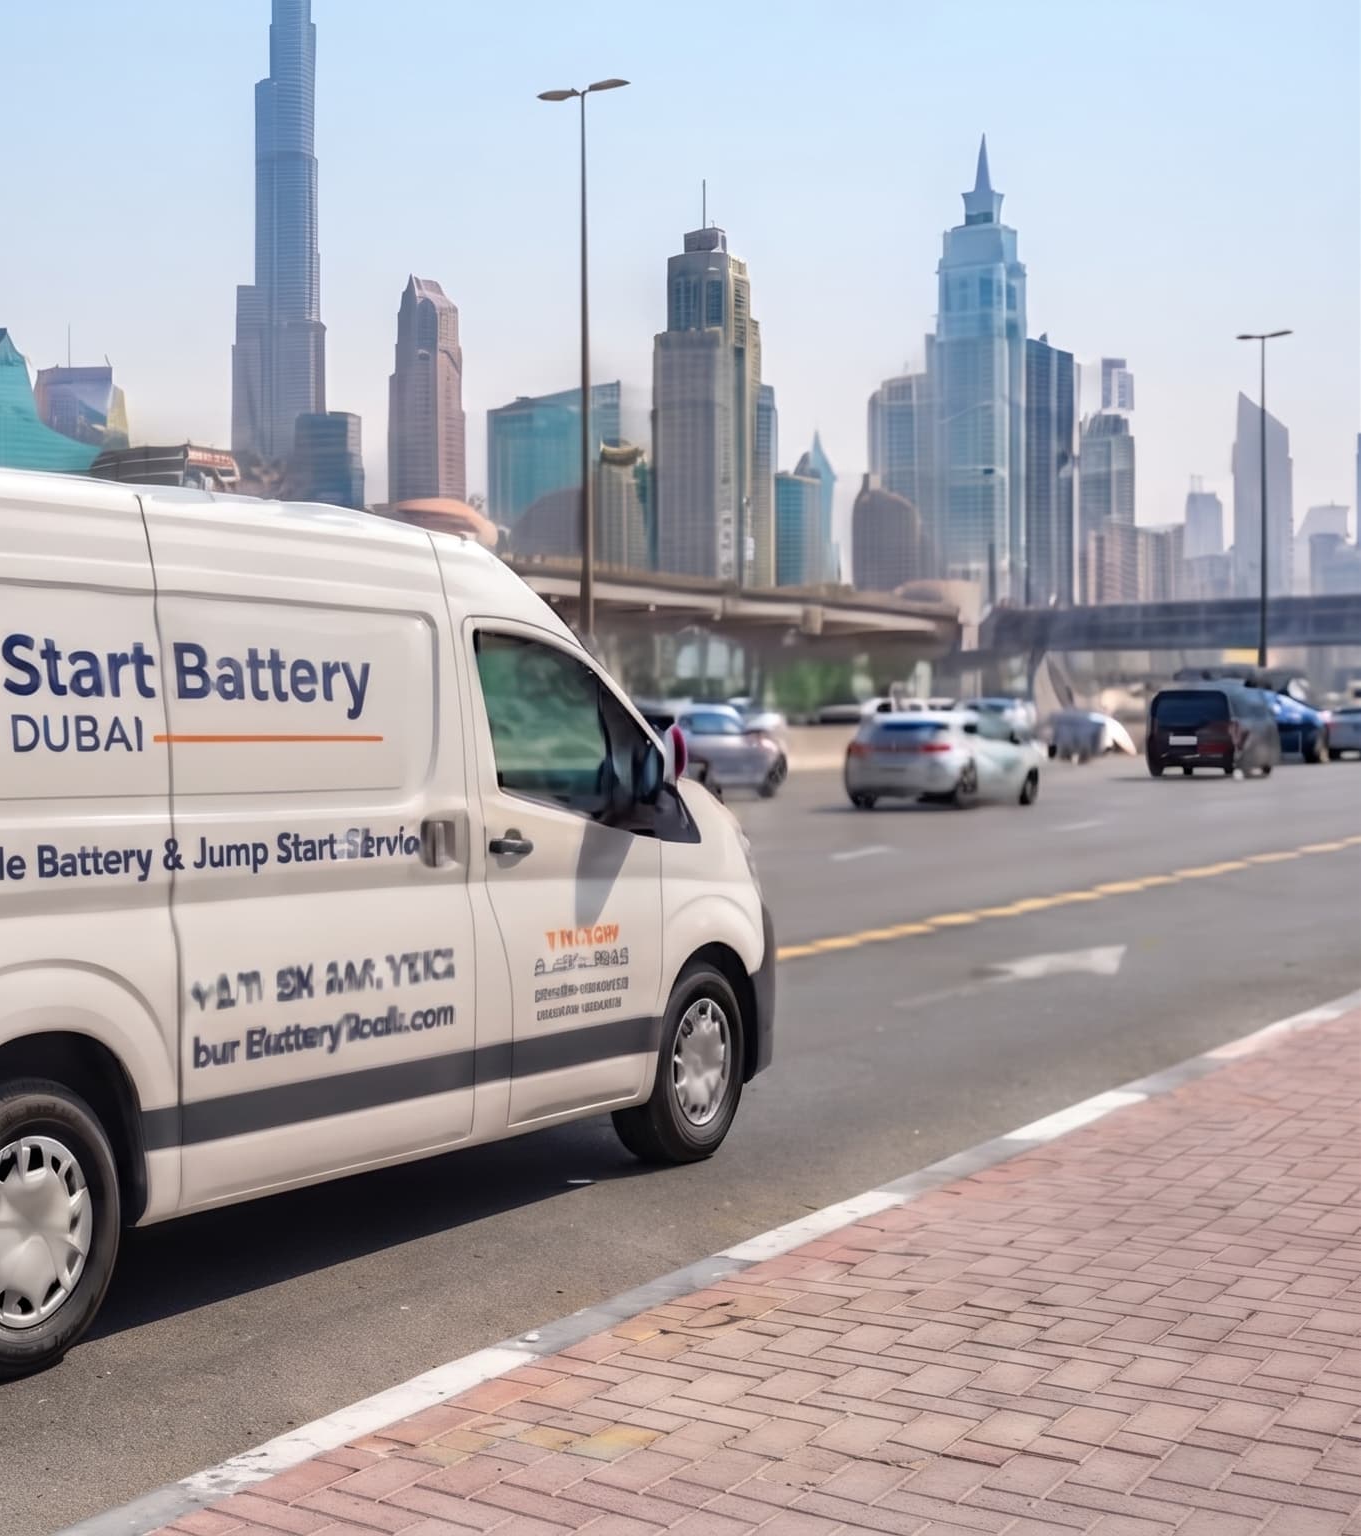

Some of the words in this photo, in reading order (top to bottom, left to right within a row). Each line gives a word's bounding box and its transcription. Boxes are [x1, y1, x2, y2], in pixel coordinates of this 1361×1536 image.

[1, 633, 156, 698] Start
[172, 641, 371, 721] Battery
[10, 713, 143, 753] DUBAI
[37, 843, 152, 882] Battery
[163, 838, 185, 870] &
[193, 836, 269, 874] Jump
[276, 832, 338, 863] Start
